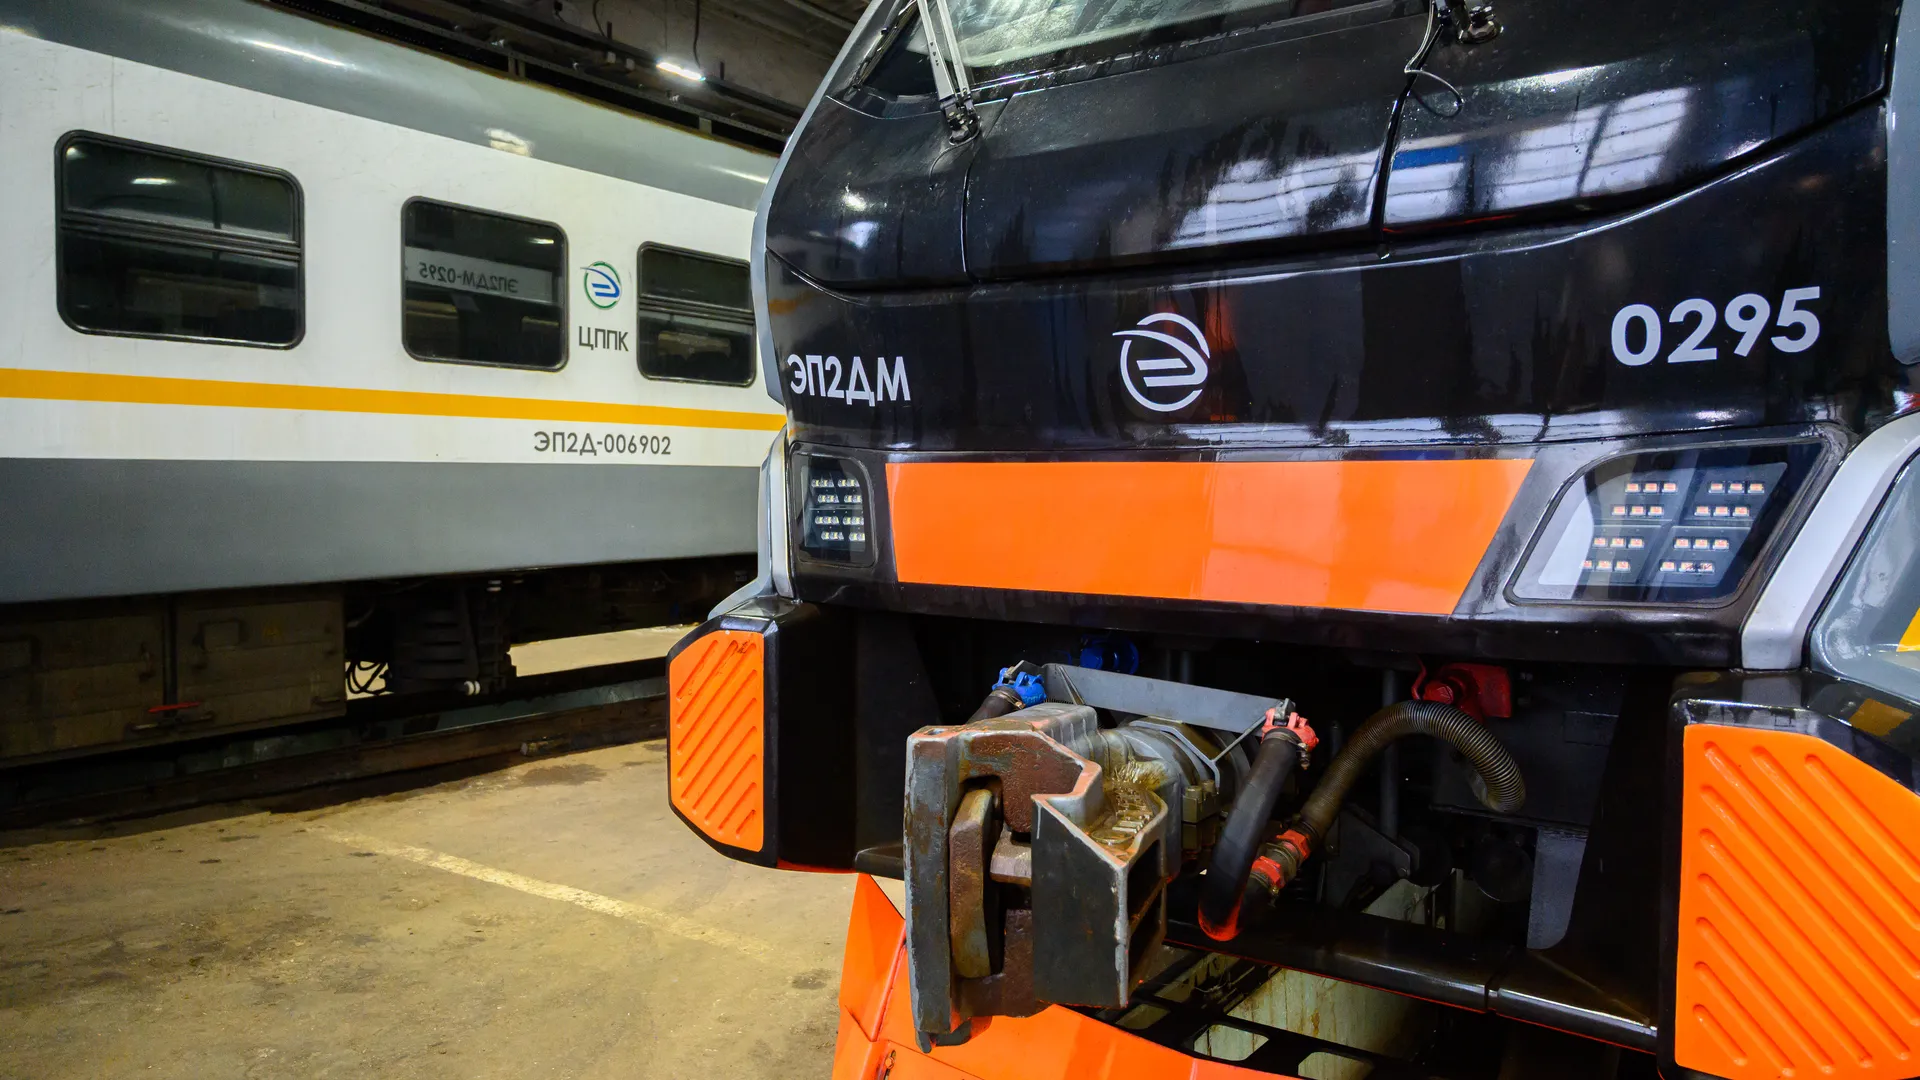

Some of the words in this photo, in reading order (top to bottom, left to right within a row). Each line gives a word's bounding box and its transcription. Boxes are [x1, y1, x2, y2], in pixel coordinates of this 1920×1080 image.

[579, 326, 629, 351] ЦППК
[1611, 286, 1820, 366] 0295
[787, 354, 911, 407] ЭП2ДМ
[534, 431, 671, 456] ЭП2Д-006902
